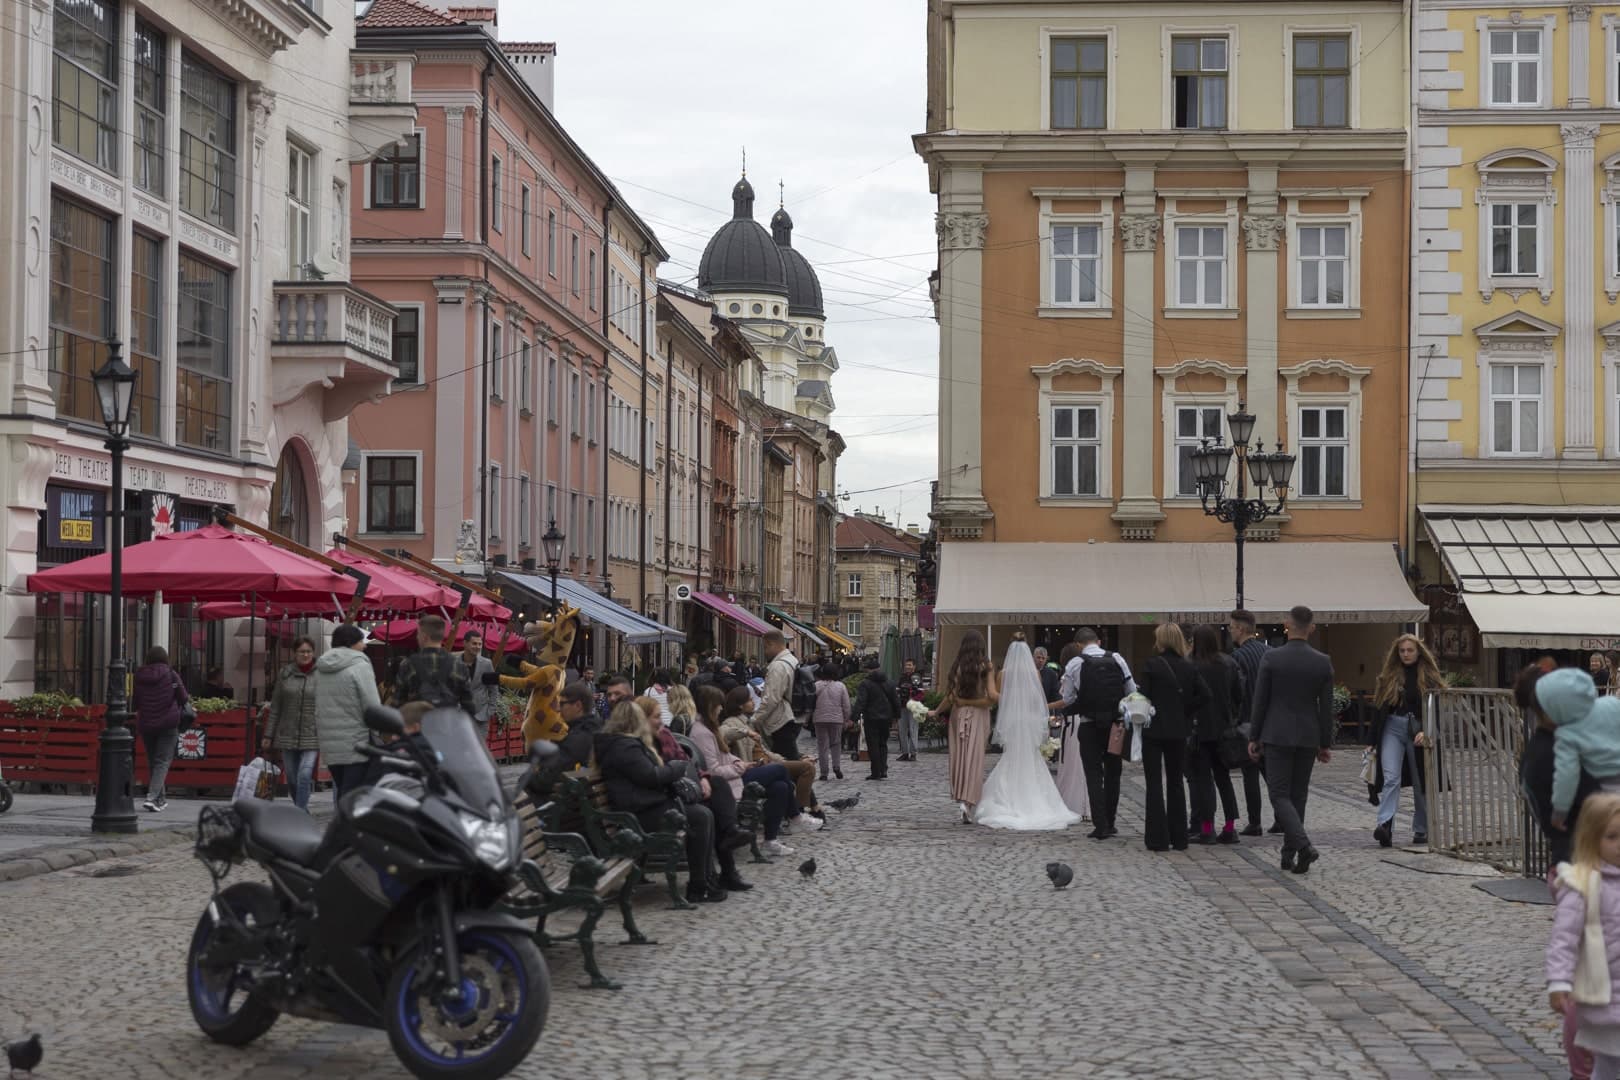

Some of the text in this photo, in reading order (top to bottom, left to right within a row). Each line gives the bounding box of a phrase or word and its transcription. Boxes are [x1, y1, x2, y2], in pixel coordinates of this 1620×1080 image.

[55, 452, 108, 481] BEER THEATRE
[60, 491, 93, 520] UKRAINE
